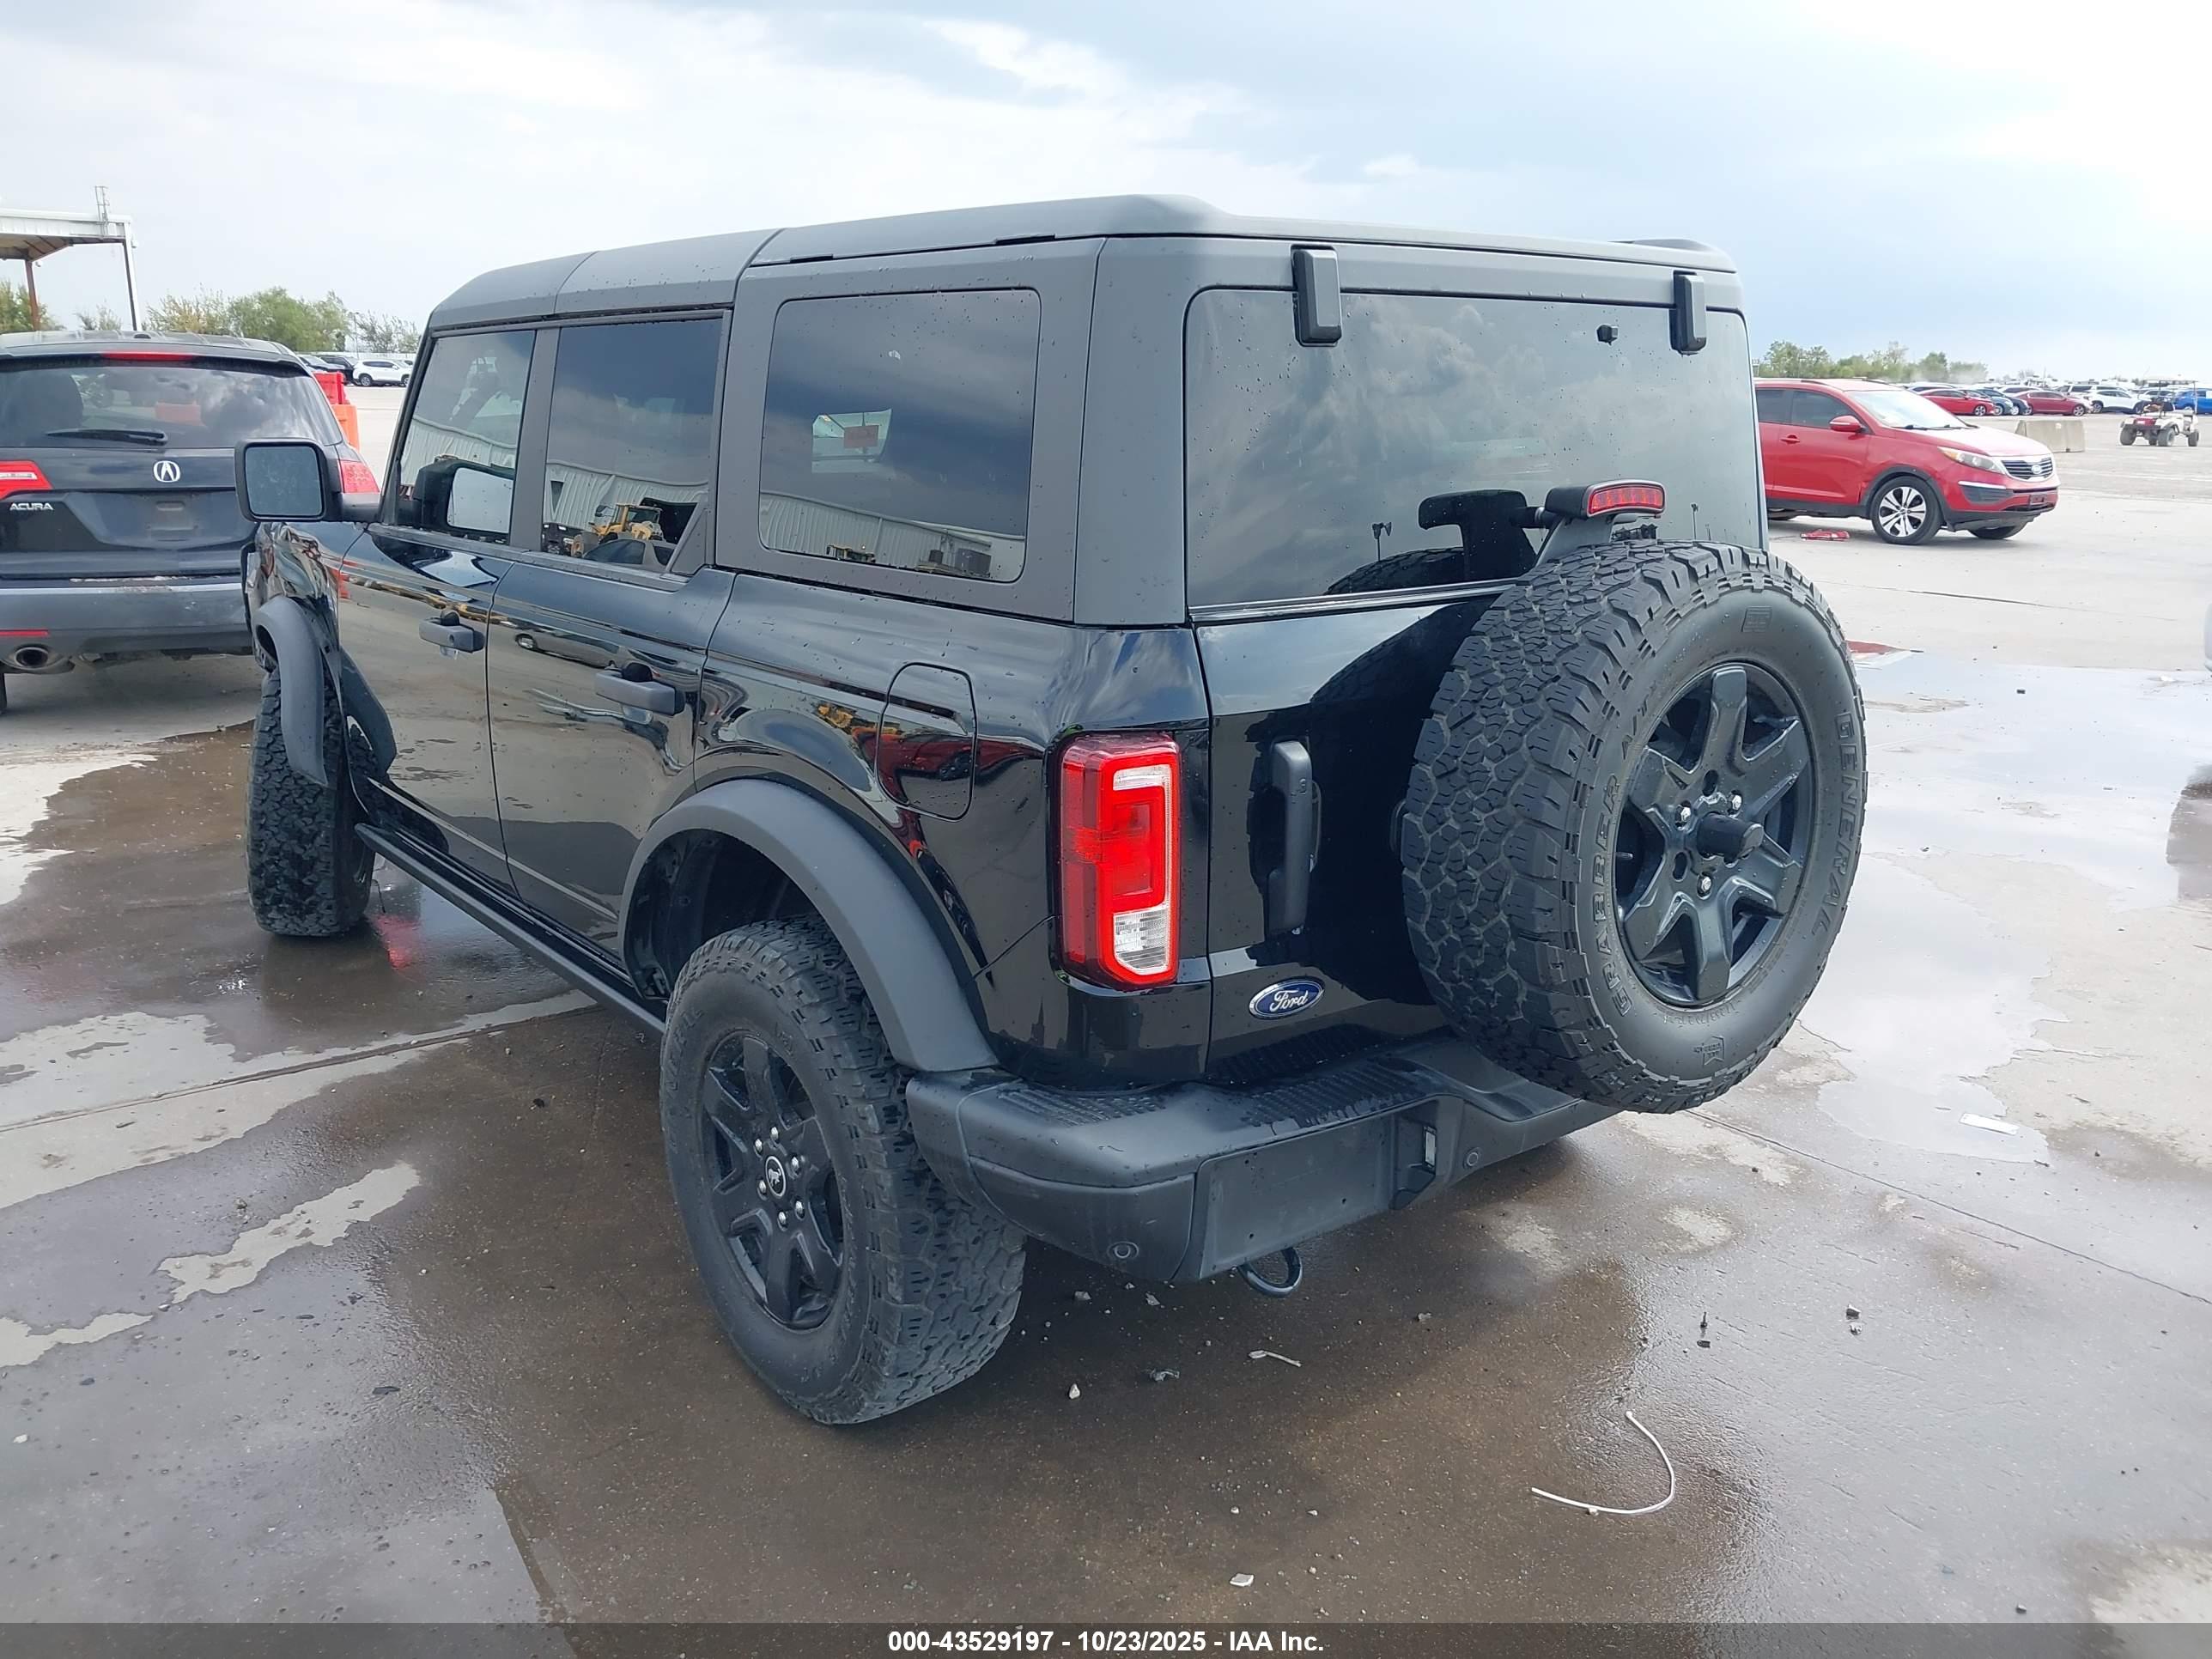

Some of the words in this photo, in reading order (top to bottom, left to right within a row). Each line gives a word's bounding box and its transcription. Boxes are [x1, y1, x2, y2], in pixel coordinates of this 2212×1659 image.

[9, 501, 54, 511] ACURA
[1811, 713, 1860, 935] GENERAL
[1593, 773, 1632, 1018] GRABBER
[1269, 988, 1309, 1012] Ford
